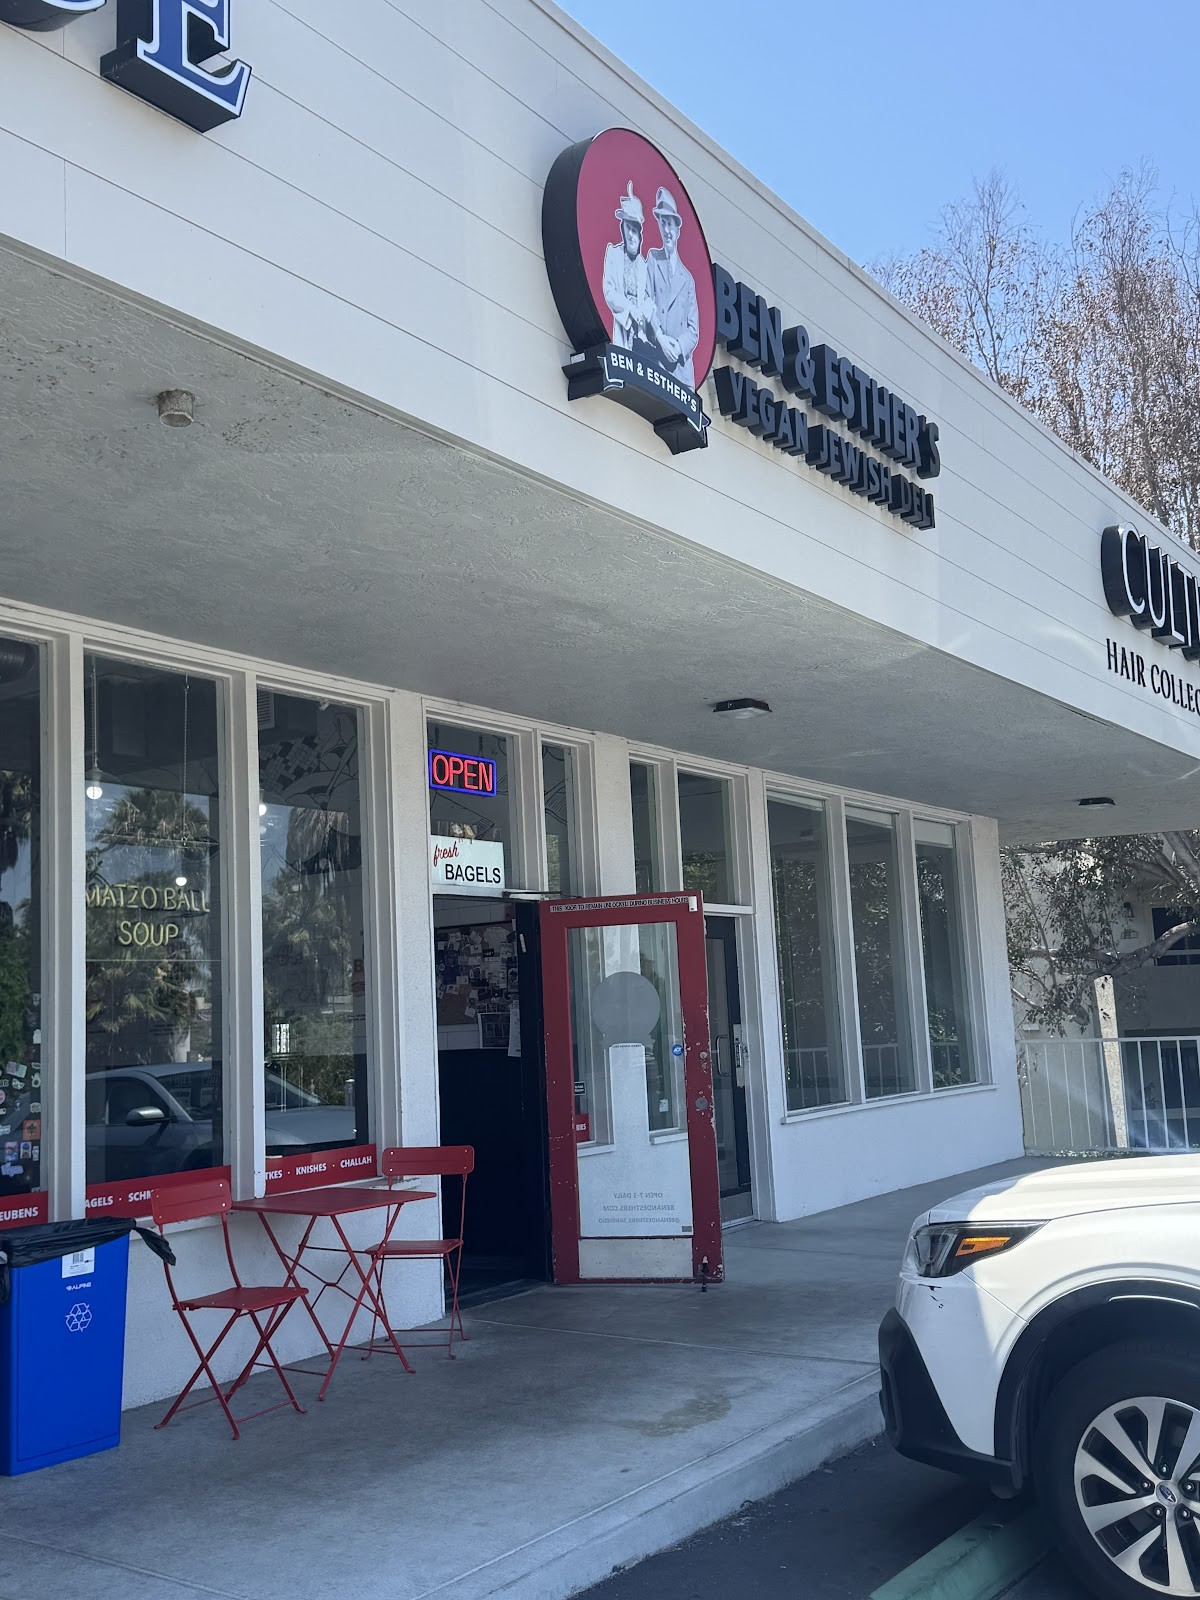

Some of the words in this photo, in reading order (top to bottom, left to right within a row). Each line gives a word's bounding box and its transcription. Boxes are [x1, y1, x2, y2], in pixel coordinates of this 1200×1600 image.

[610, 352, 634, 373] BEN
[636, 362, 645, 377] &
[646, 367, 698, 412] ESTHER'S
[713, 262, 784, 377] BEN
[783, 325, 817, 400] &
[811, 343, 941, 480] ESTHER'S
[715, 365, 808, 455] VEGAN
[807, 424, 893, 506] JEWISH
[890, 474, 936, 531] DELI
[1102, 521, 1200, 657] CULT
[1106, 638, 1146, 688] HAIR
[432, 754, 493, 792] OPEN
[433, 841, 459, 867] fresh
[445, 863, 501, 884] BAGELS
[163, 887, 210, 912] BALL
[118, 920, 179, 947] SOUP
[296, 1163, 327, 1175] KNISHES
[340, 1156, 372, 1168] CHALLAH
[86, 1196, 113, 1209] AGELS
